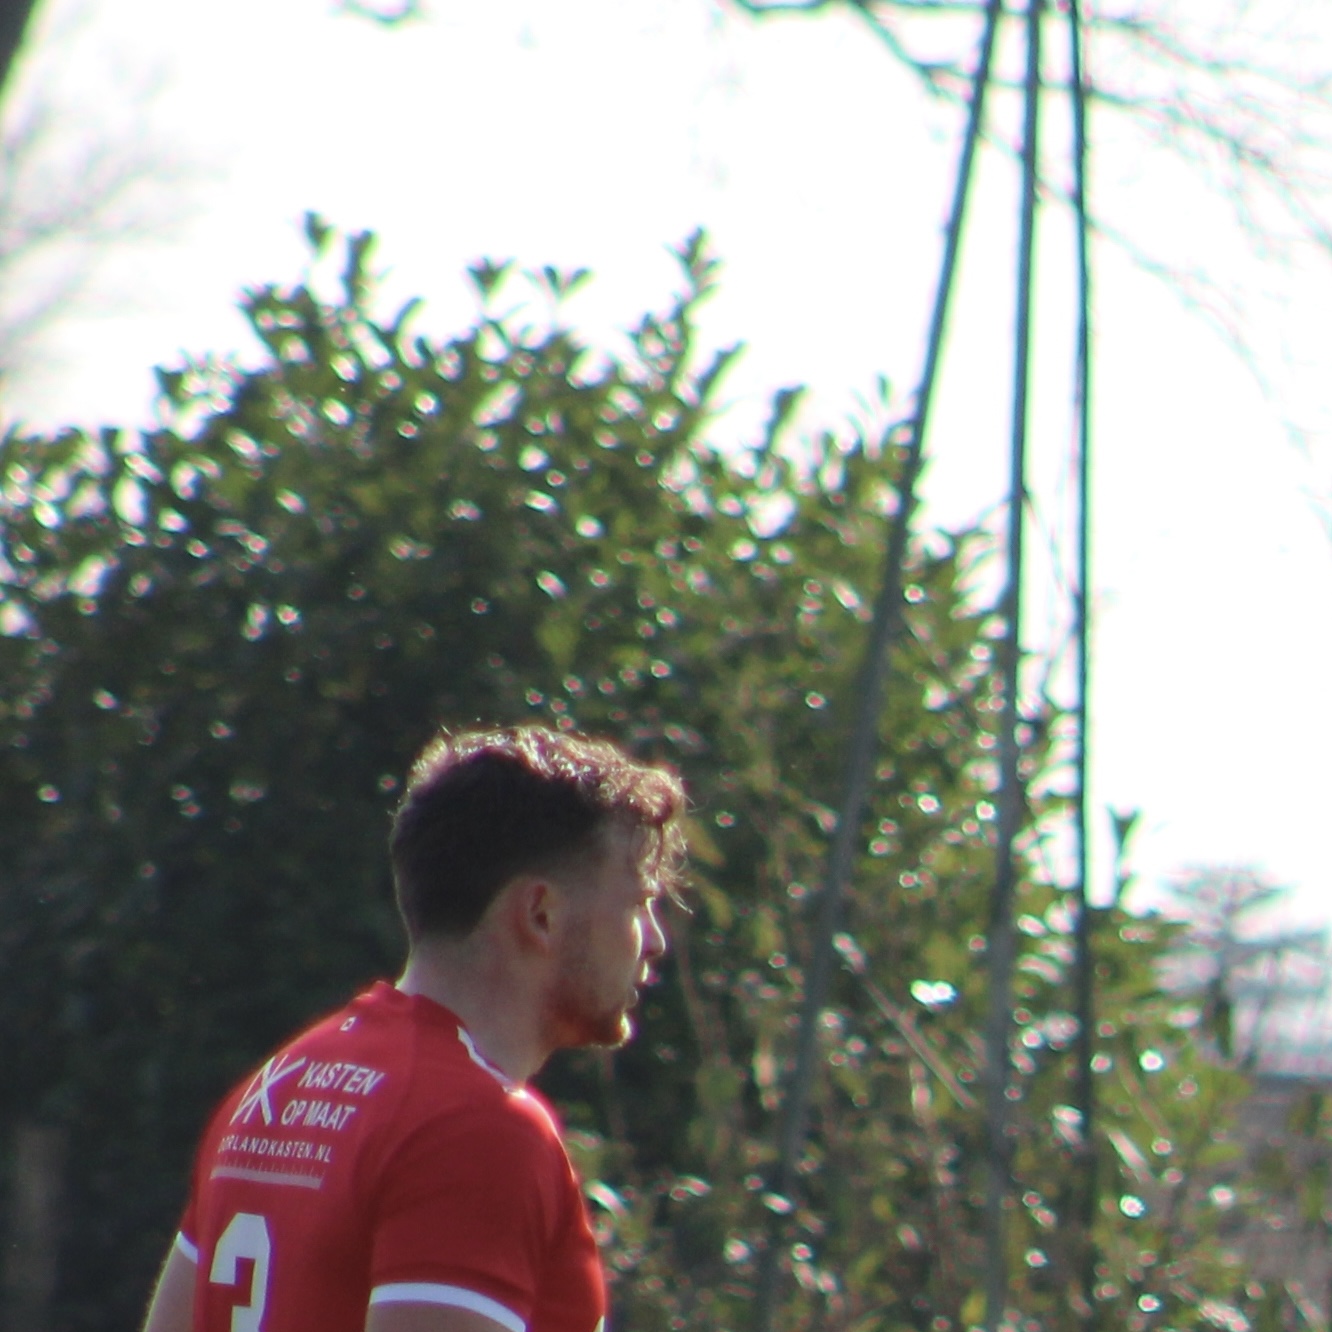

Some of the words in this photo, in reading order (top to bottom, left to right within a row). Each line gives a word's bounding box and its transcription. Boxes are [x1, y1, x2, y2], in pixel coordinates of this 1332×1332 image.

[297, 1061, 386, 1096] KASTEN
[280, 1100, 305, 1127] OP
[302, 1100, 357, 1131] MAAT
